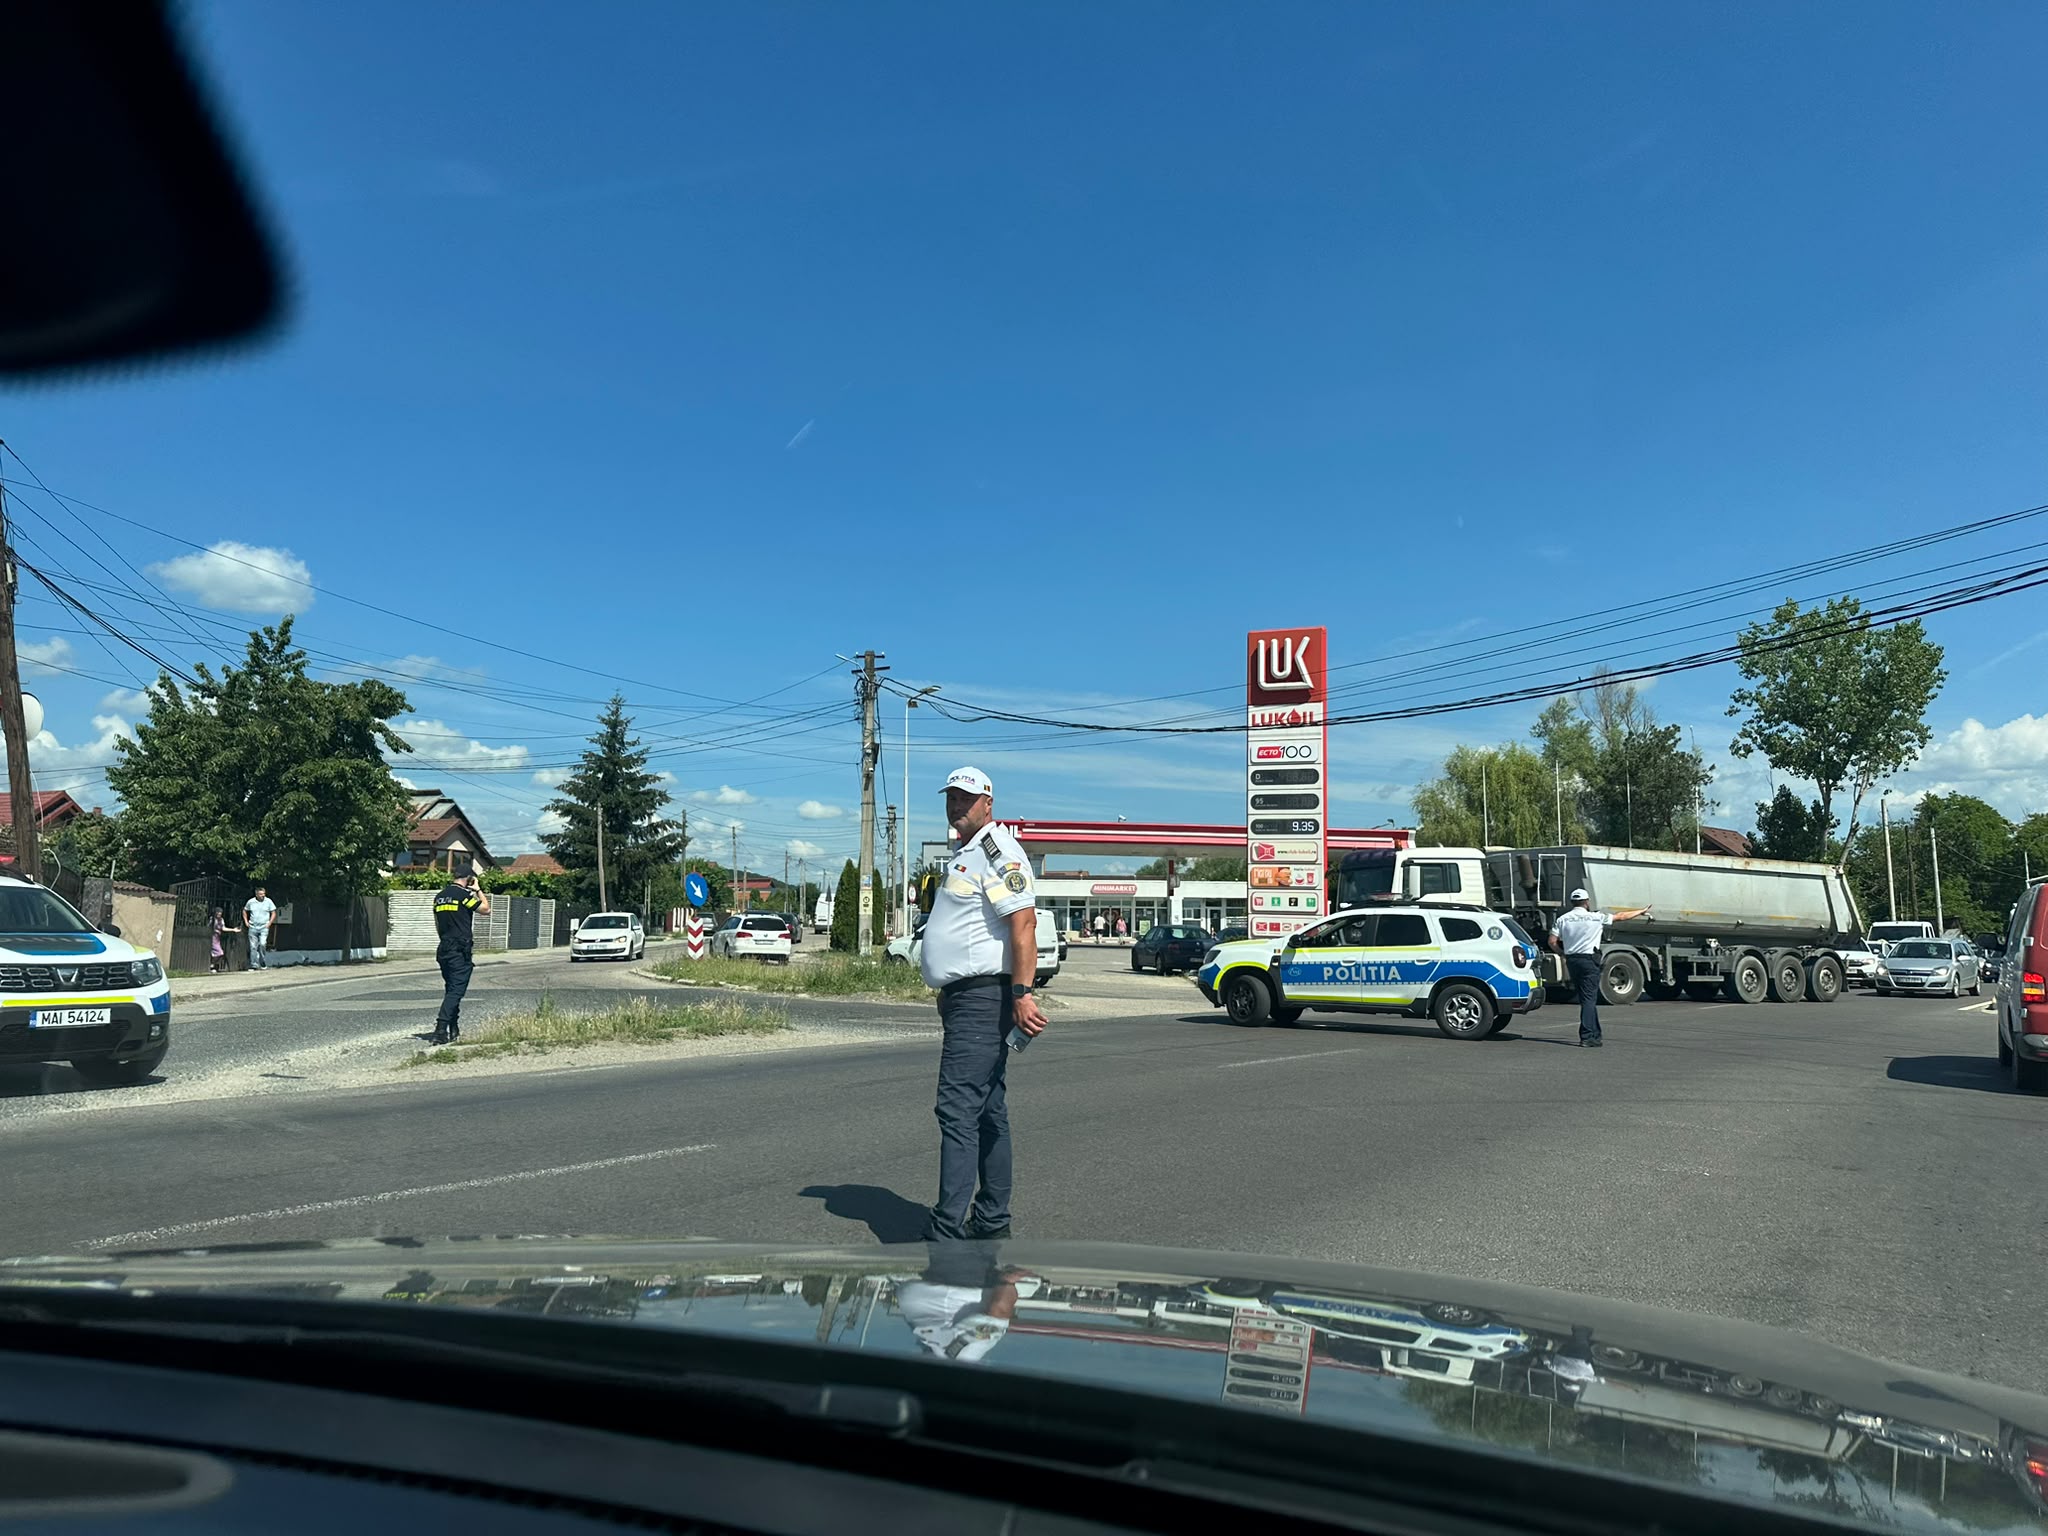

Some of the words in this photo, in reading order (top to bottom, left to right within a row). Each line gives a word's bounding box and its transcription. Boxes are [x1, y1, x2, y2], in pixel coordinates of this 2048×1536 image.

[1251, 708, 1314, 727] LUKOIL
[1258, 748, 1279, 756] ECTO
[1279, 745, 1312, 759] 100
[1292, 821, 1315, 832] 9.35
[1323, 966, 1402, 981] POLITIA
[41, 1012, 62, 1025] MAI
[67, 1011, 104, 1024] 54124
